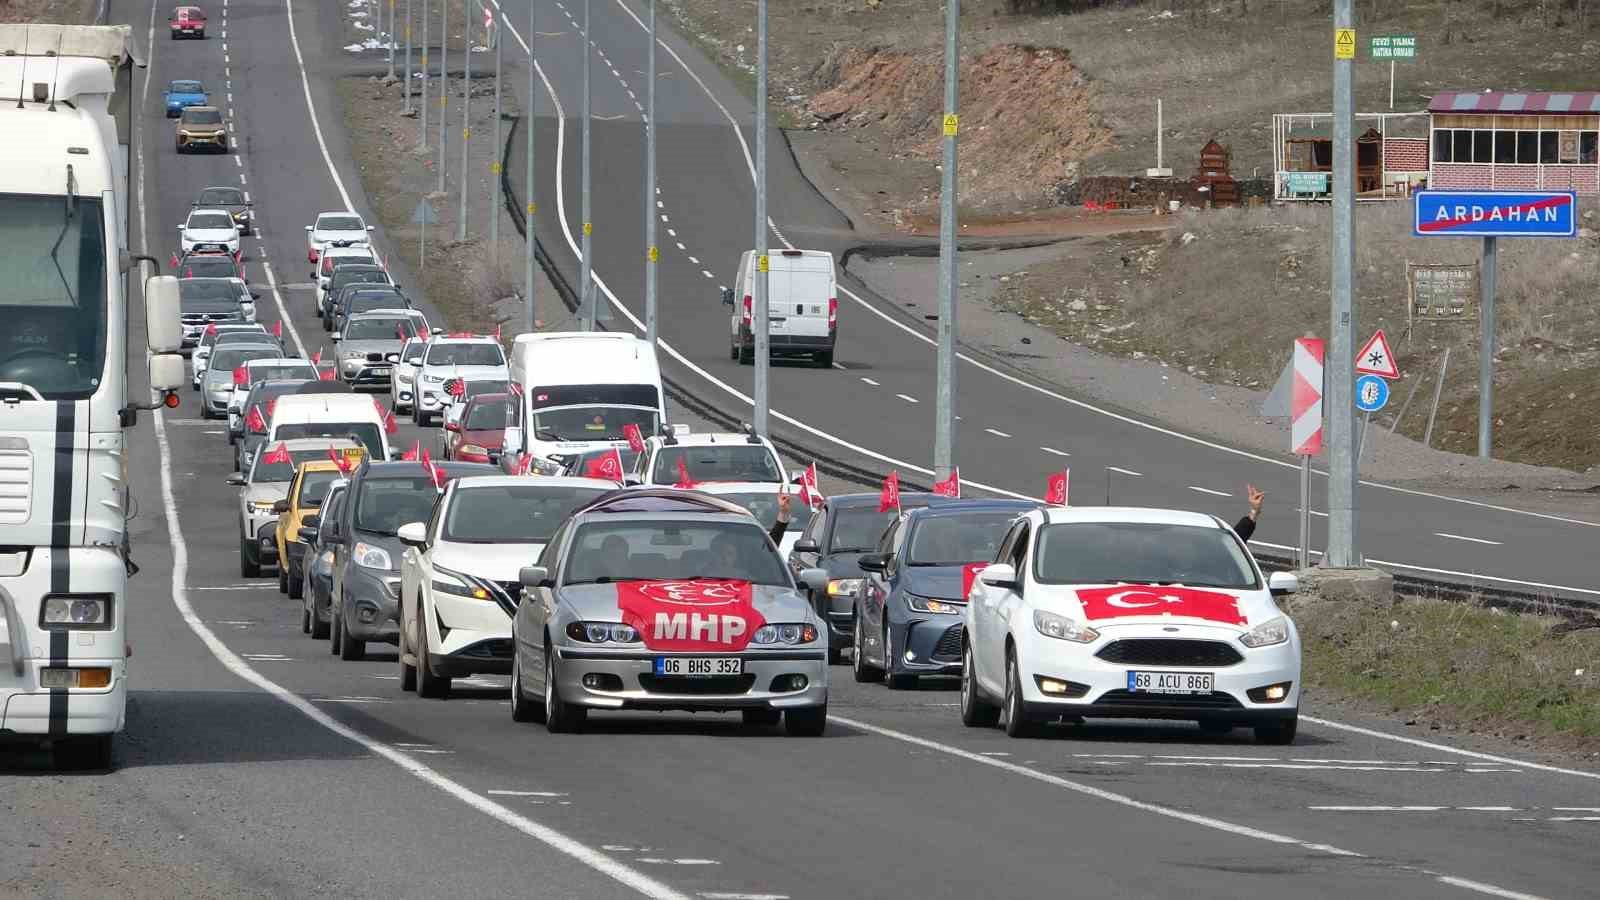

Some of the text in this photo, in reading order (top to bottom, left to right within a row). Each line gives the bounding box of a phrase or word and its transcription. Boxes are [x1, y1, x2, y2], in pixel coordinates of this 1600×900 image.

[1435, 205, 1557, 222] ARDAHAN
[653, 612, 747, 644] MHP
[665, 659, 740, 673] 06 BHS 352
[1136, 674, 1210, 689] 68 ACU 866
